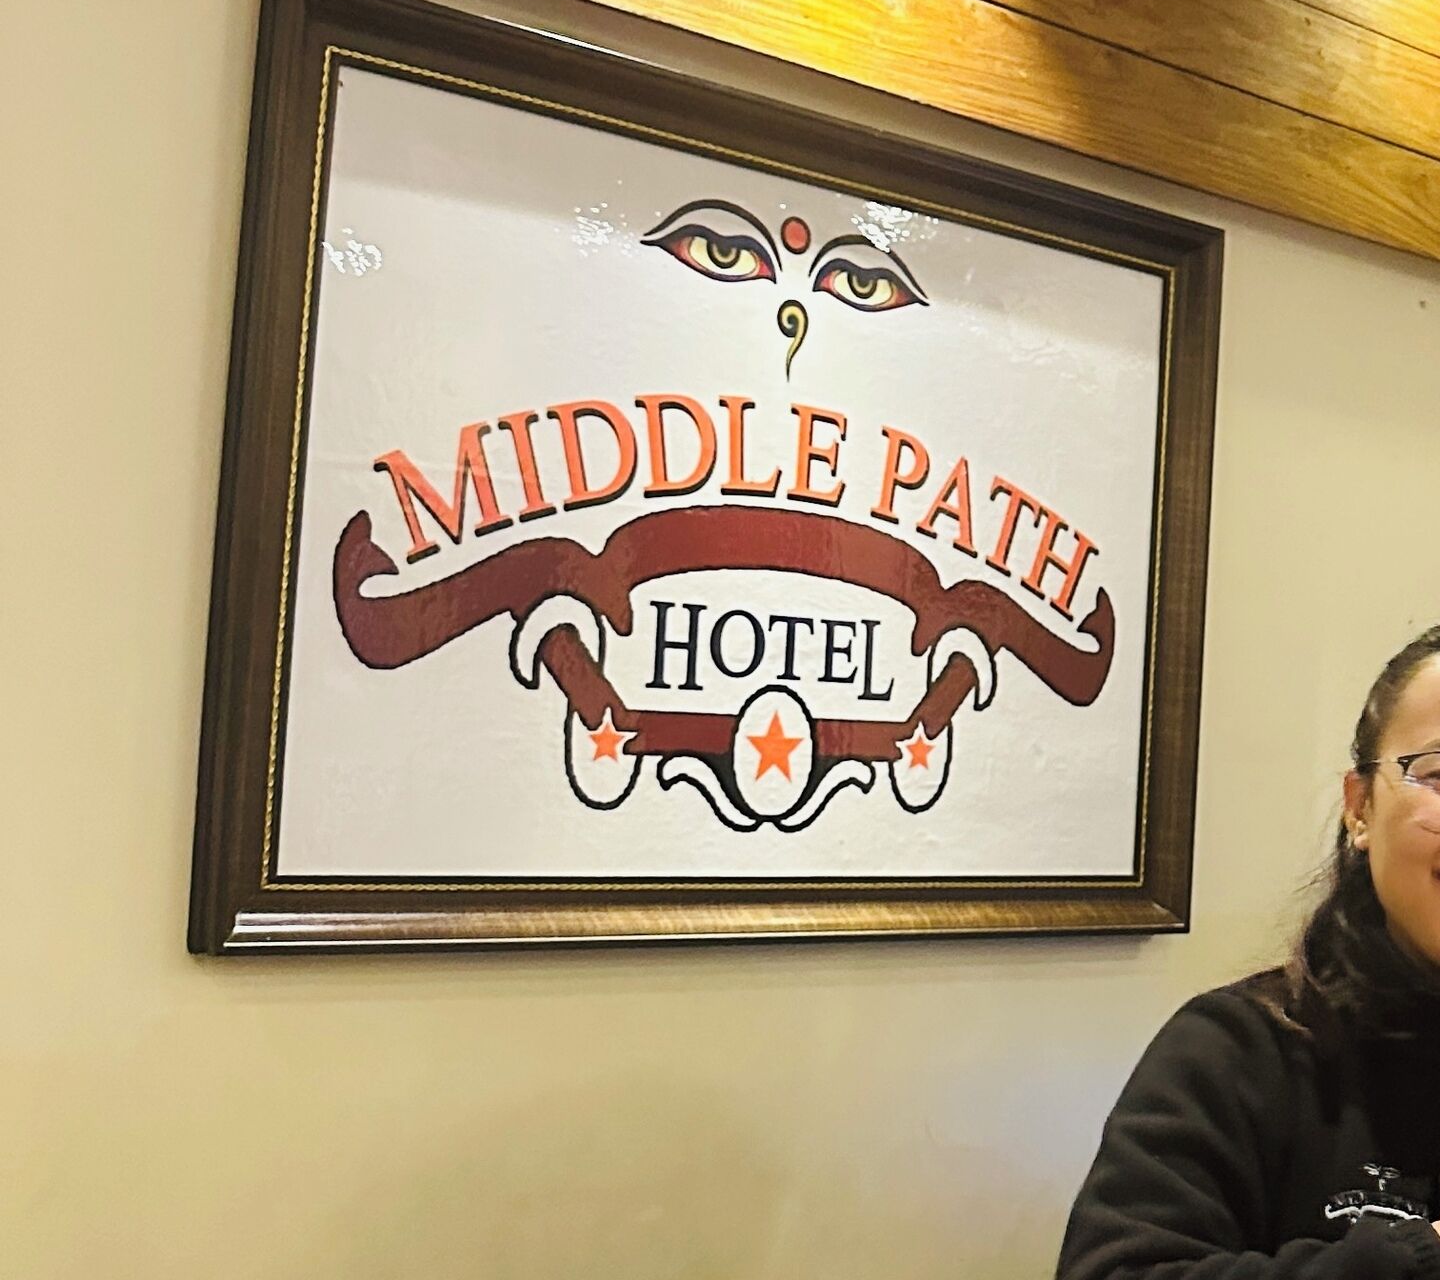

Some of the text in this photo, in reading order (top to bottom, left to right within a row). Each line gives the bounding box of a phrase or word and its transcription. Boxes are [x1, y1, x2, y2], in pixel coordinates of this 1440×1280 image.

[374, 394, 1100, 622] MIDDLE PATH
[645, 600, 895, 704] HOTEL
